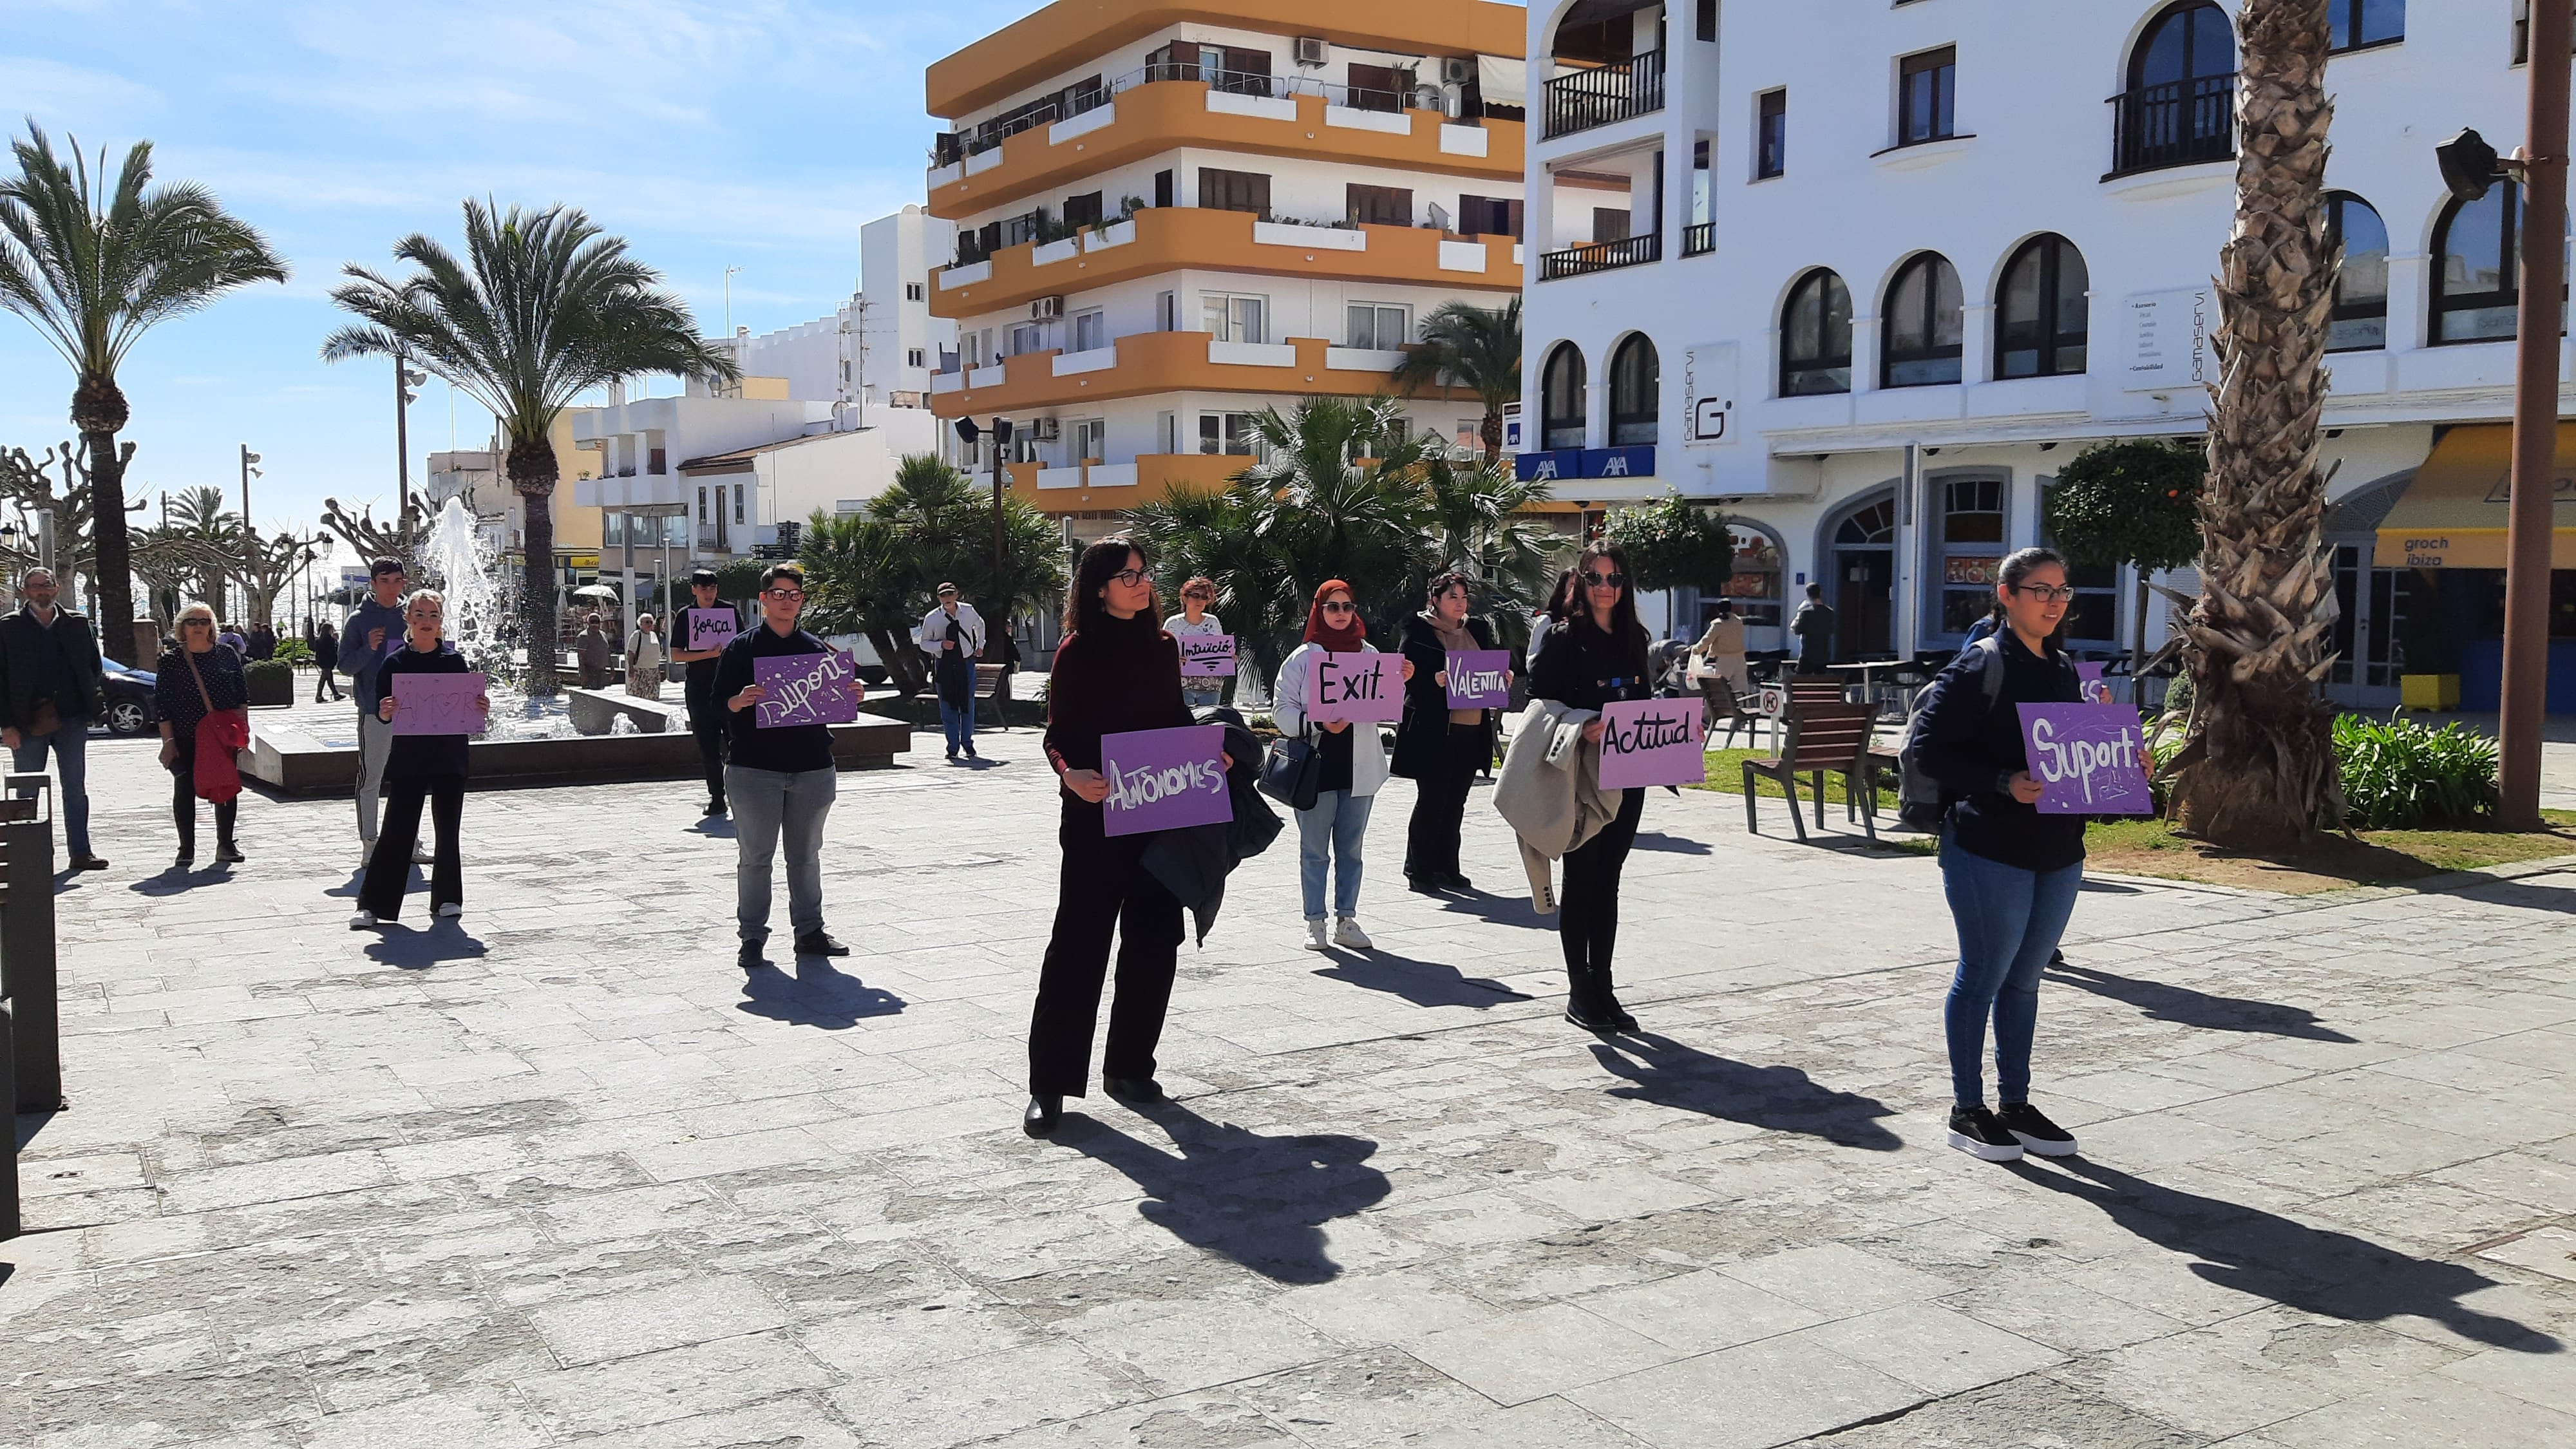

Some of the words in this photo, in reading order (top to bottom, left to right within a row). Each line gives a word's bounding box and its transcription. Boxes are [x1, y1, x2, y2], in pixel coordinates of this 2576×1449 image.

[1534, 459, 1558, 478] AXA
[1601, 456, 1629, 477] AXA
[2405, 536, 2450, 552] groch
[2407, 553, 2442, 565] ibiza
